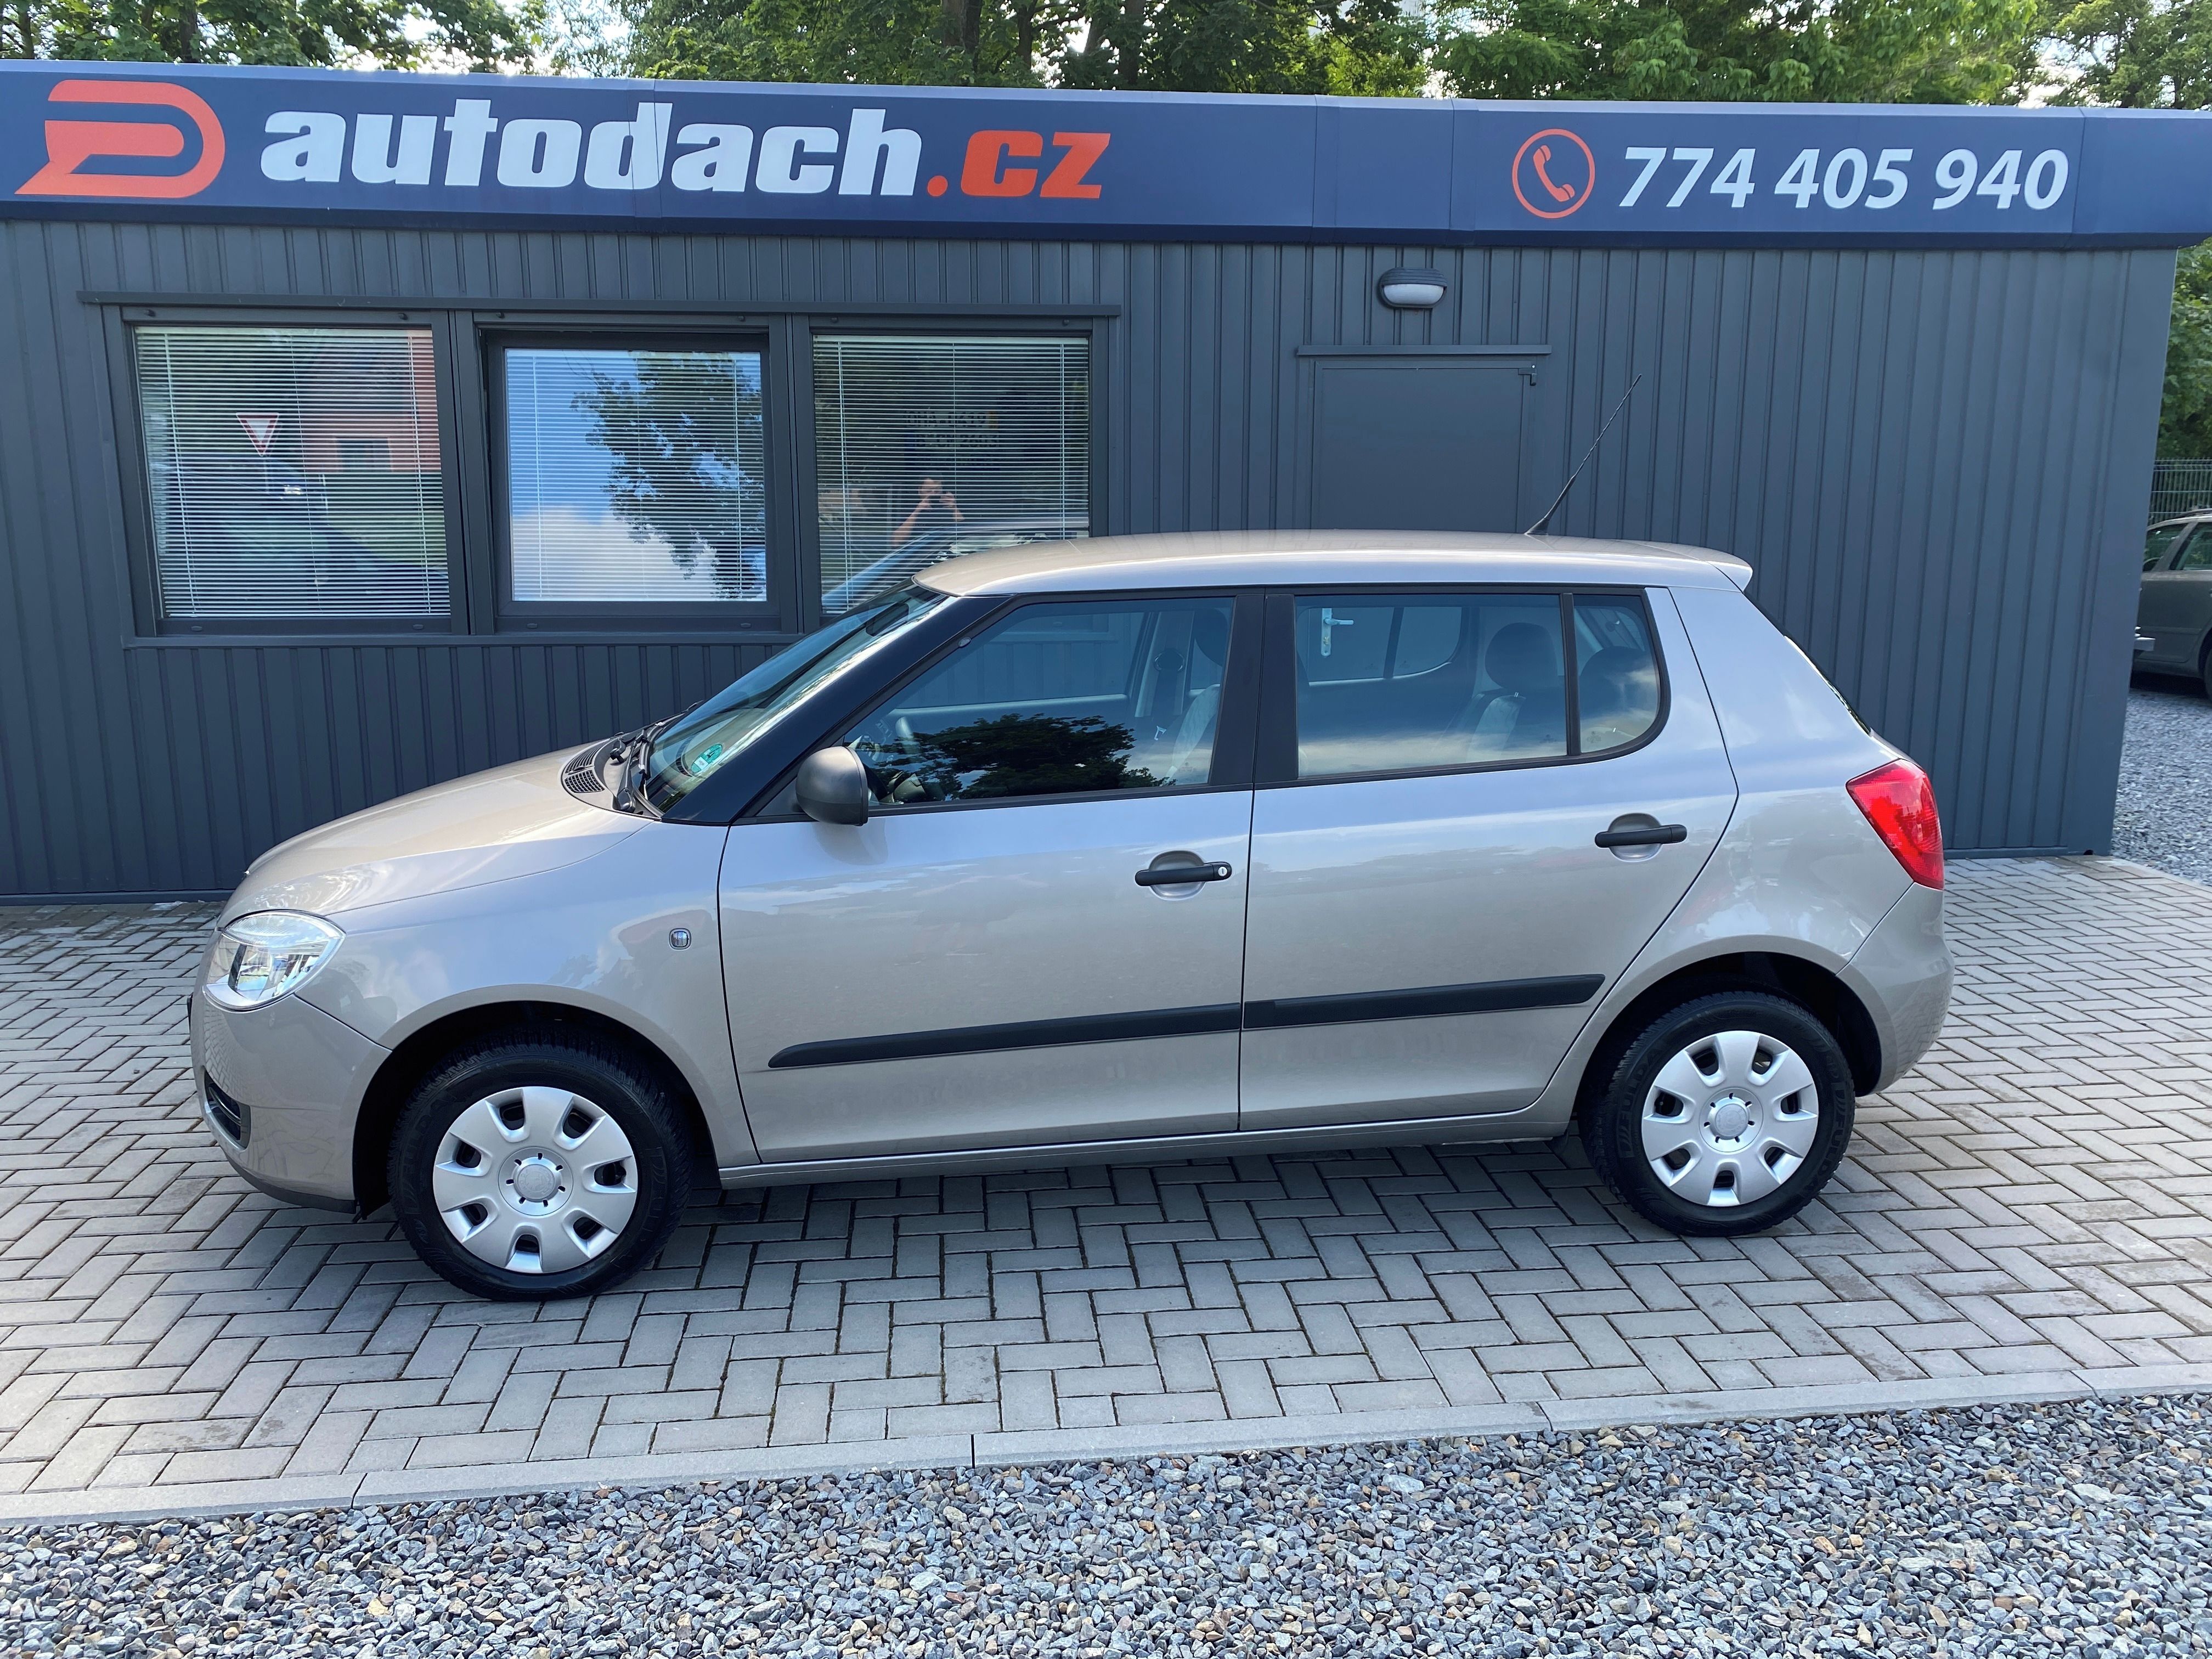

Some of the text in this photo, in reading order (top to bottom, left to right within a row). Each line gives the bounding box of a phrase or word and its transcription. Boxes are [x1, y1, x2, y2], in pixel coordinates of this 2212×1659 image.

[260, 98, 1111, 198] autodach.cz
[1618, 146, 2069, 210] 774 405 940
